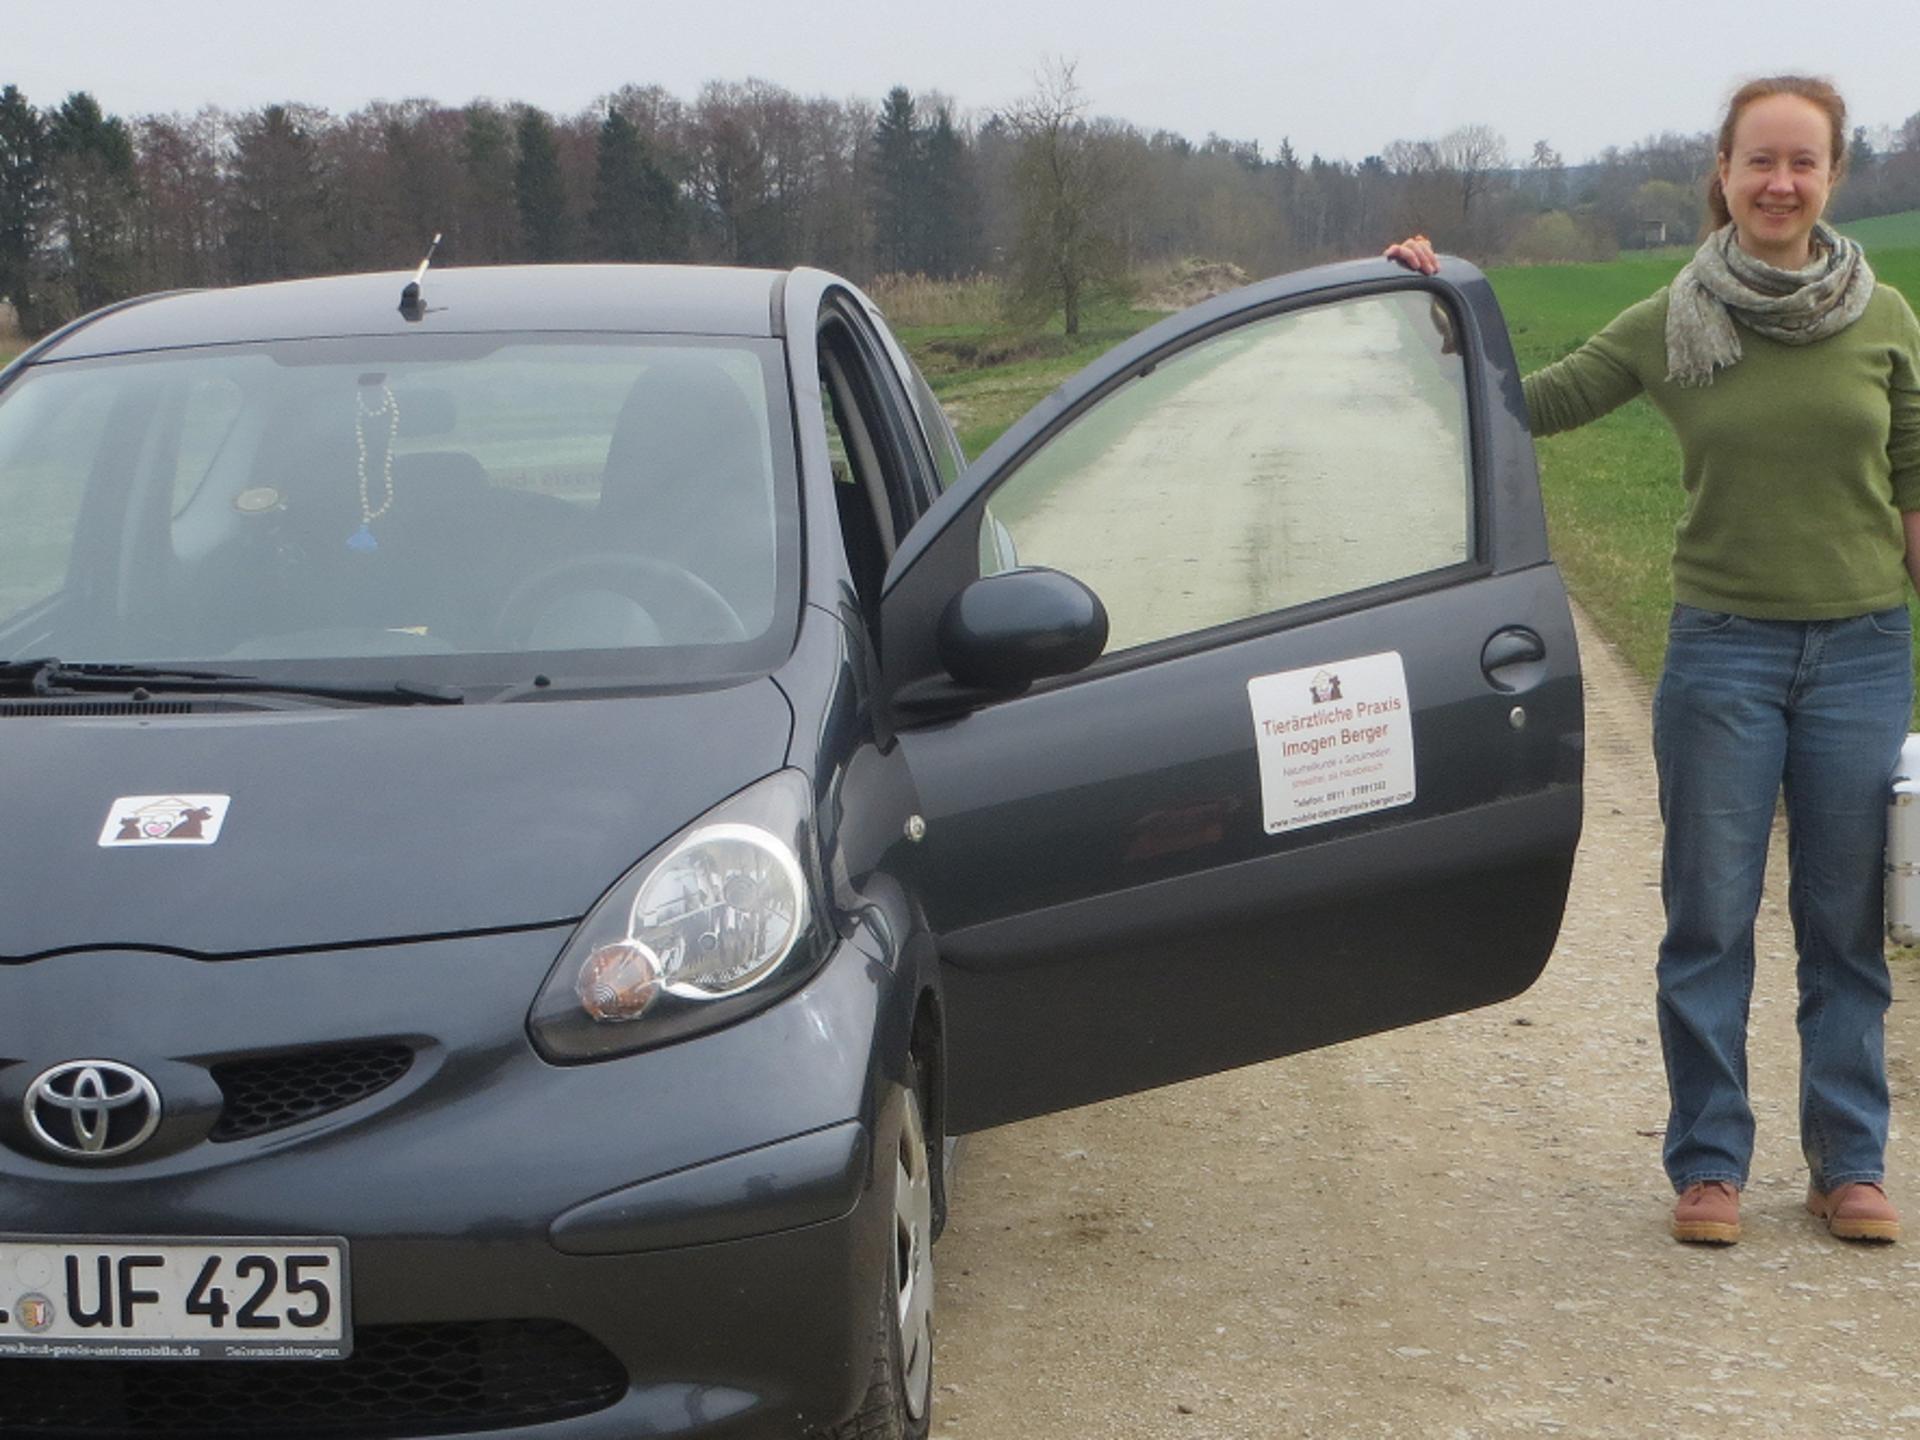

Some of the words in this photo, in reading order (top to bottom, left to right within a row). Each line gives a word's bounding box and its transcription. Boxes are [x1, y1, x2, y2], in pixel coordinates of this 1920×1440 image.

[1263, 706, 1353, 736] Tierärztliche
[1357, 696, 1401, 719] Praxis
[1283, 734, 1336, 758] Imogen
[1341, 723, 1388, 746] Berger
[65, 1255, 165, 1328] UF
[186, 1255, 331, 1328] 425
